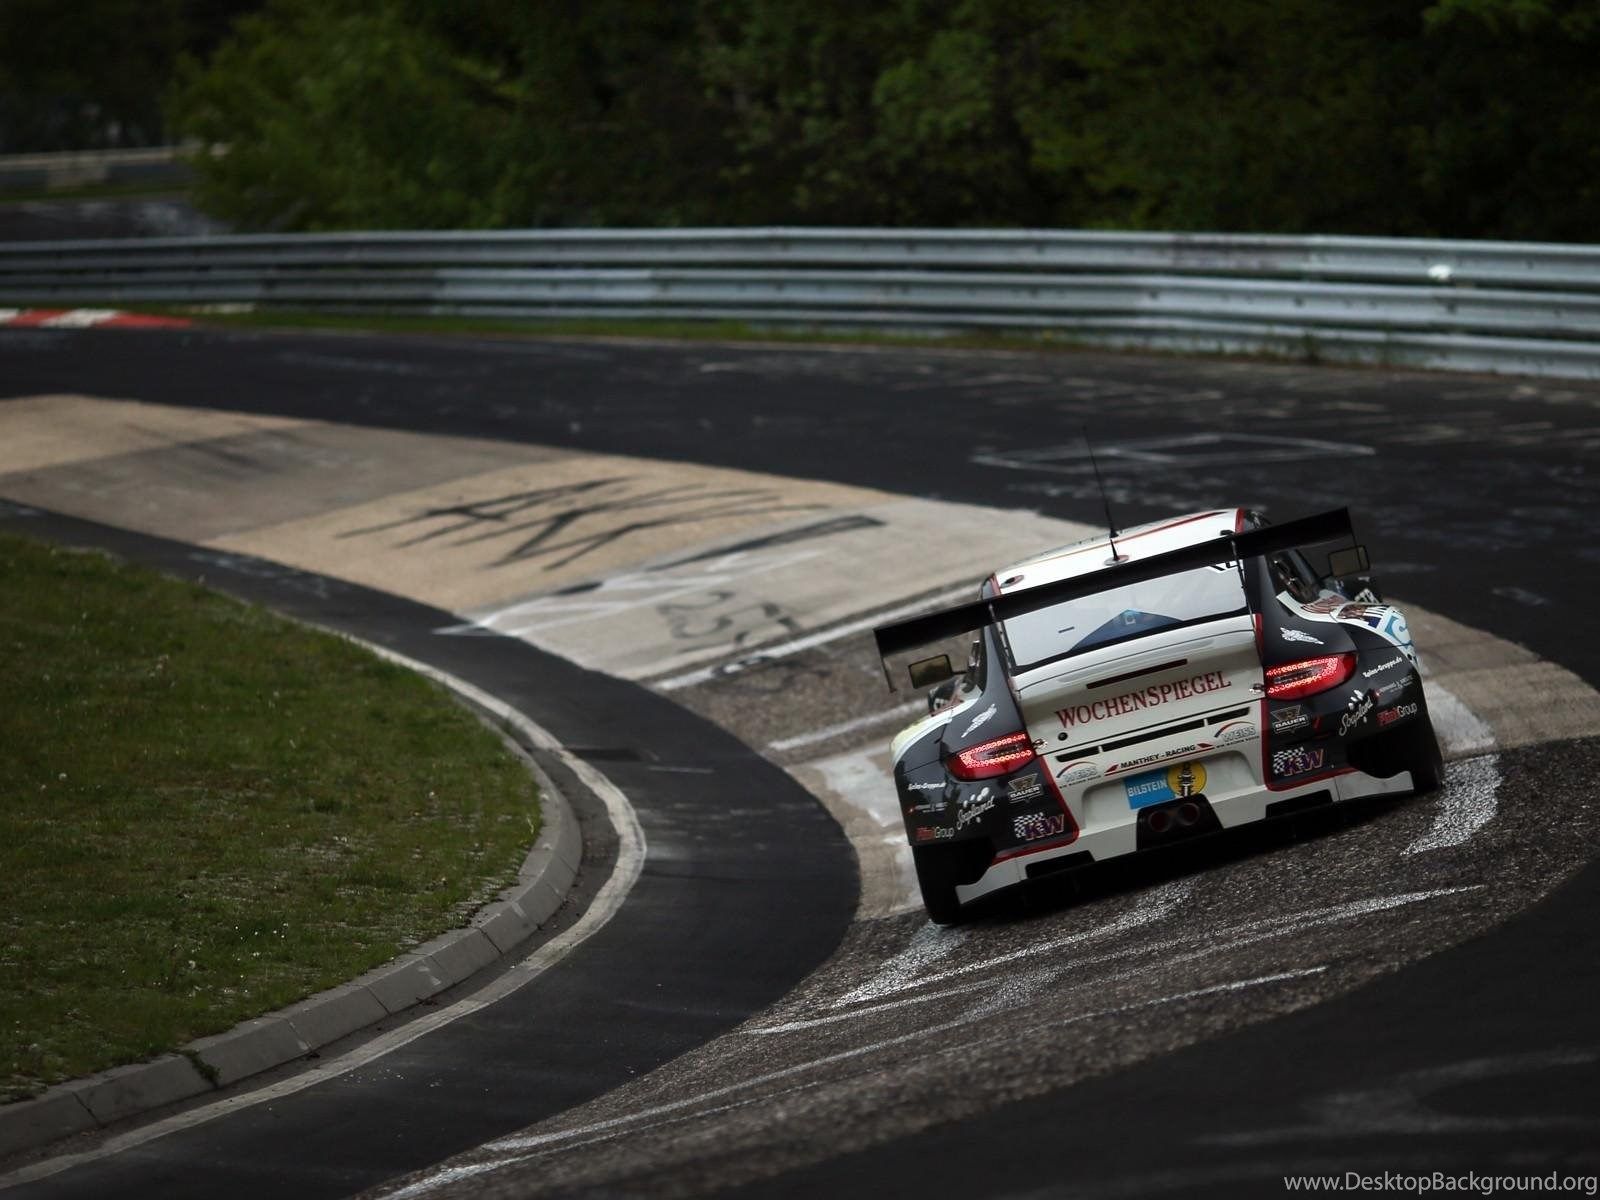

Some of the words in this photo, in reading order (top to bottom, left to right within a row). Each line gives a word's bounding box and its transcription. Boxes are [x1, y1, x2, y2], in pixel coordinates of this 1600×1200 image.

[1055, 671, 1232, 729] WOCHENSPIEGEL
[1221, 727, 1257, 742] WEISS
[1119, 754, 1159, 769] MANTHEY
[1165, 745, 1196, 758] RACING
[1282, 749, 1324, 776] KW
[1127, 779, 1168, 798] BILSTEIN
[1024, 815, 1065, 841] KW
